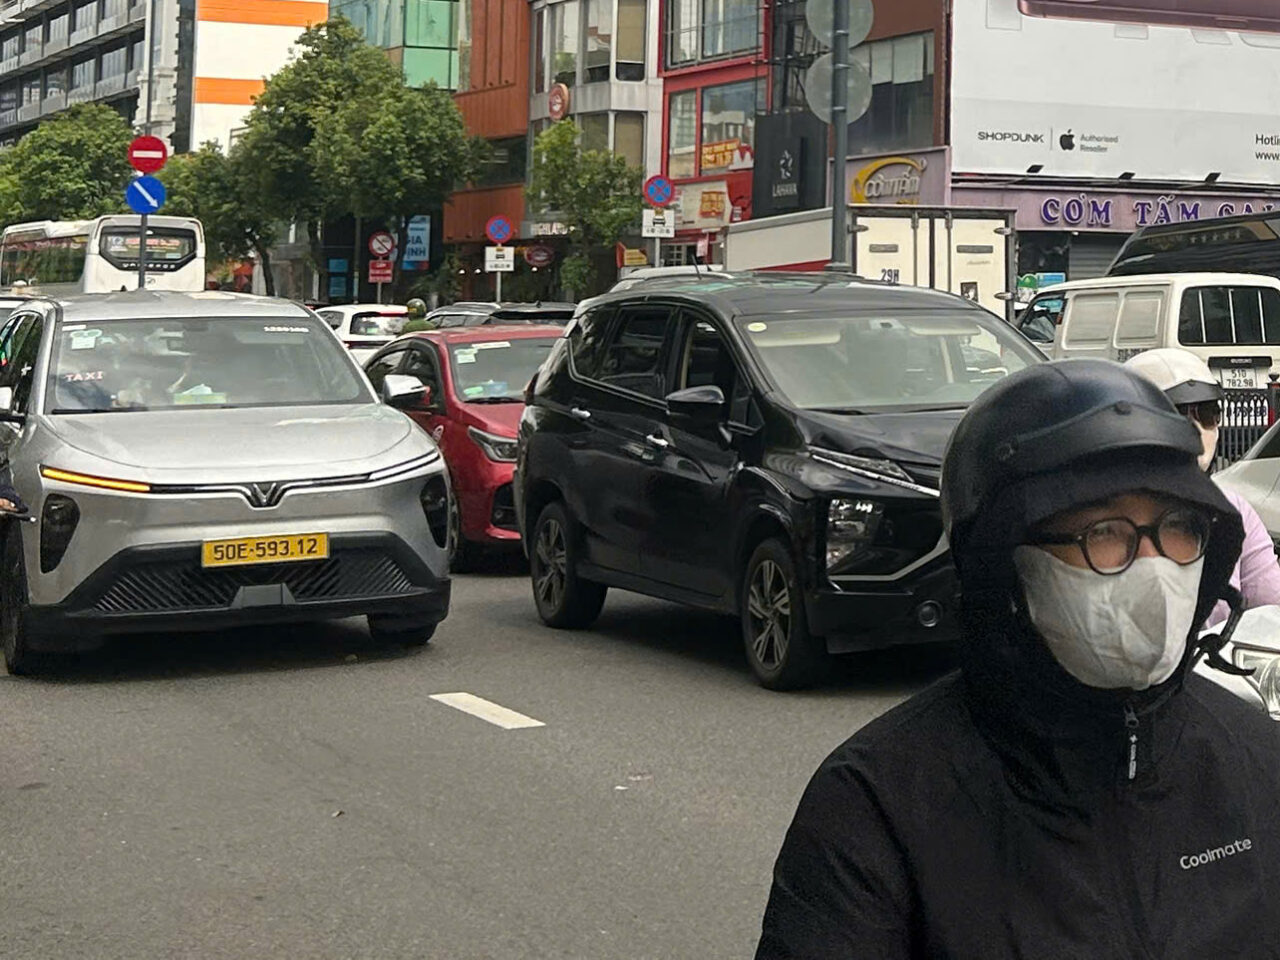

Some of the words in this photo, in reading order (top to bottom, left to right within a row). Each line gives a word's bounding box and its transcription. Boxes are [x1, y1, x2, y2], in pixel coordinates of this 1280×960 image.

[978, 131, 1044, 143] SHOPDUNK
[1041, 193, 1113, 228] CƠM
[65, 370, 104, 382] TAXI
[213, 537, 318, 561] 50E-593.12
[1180, 838, 1252, 870] Coolmate
